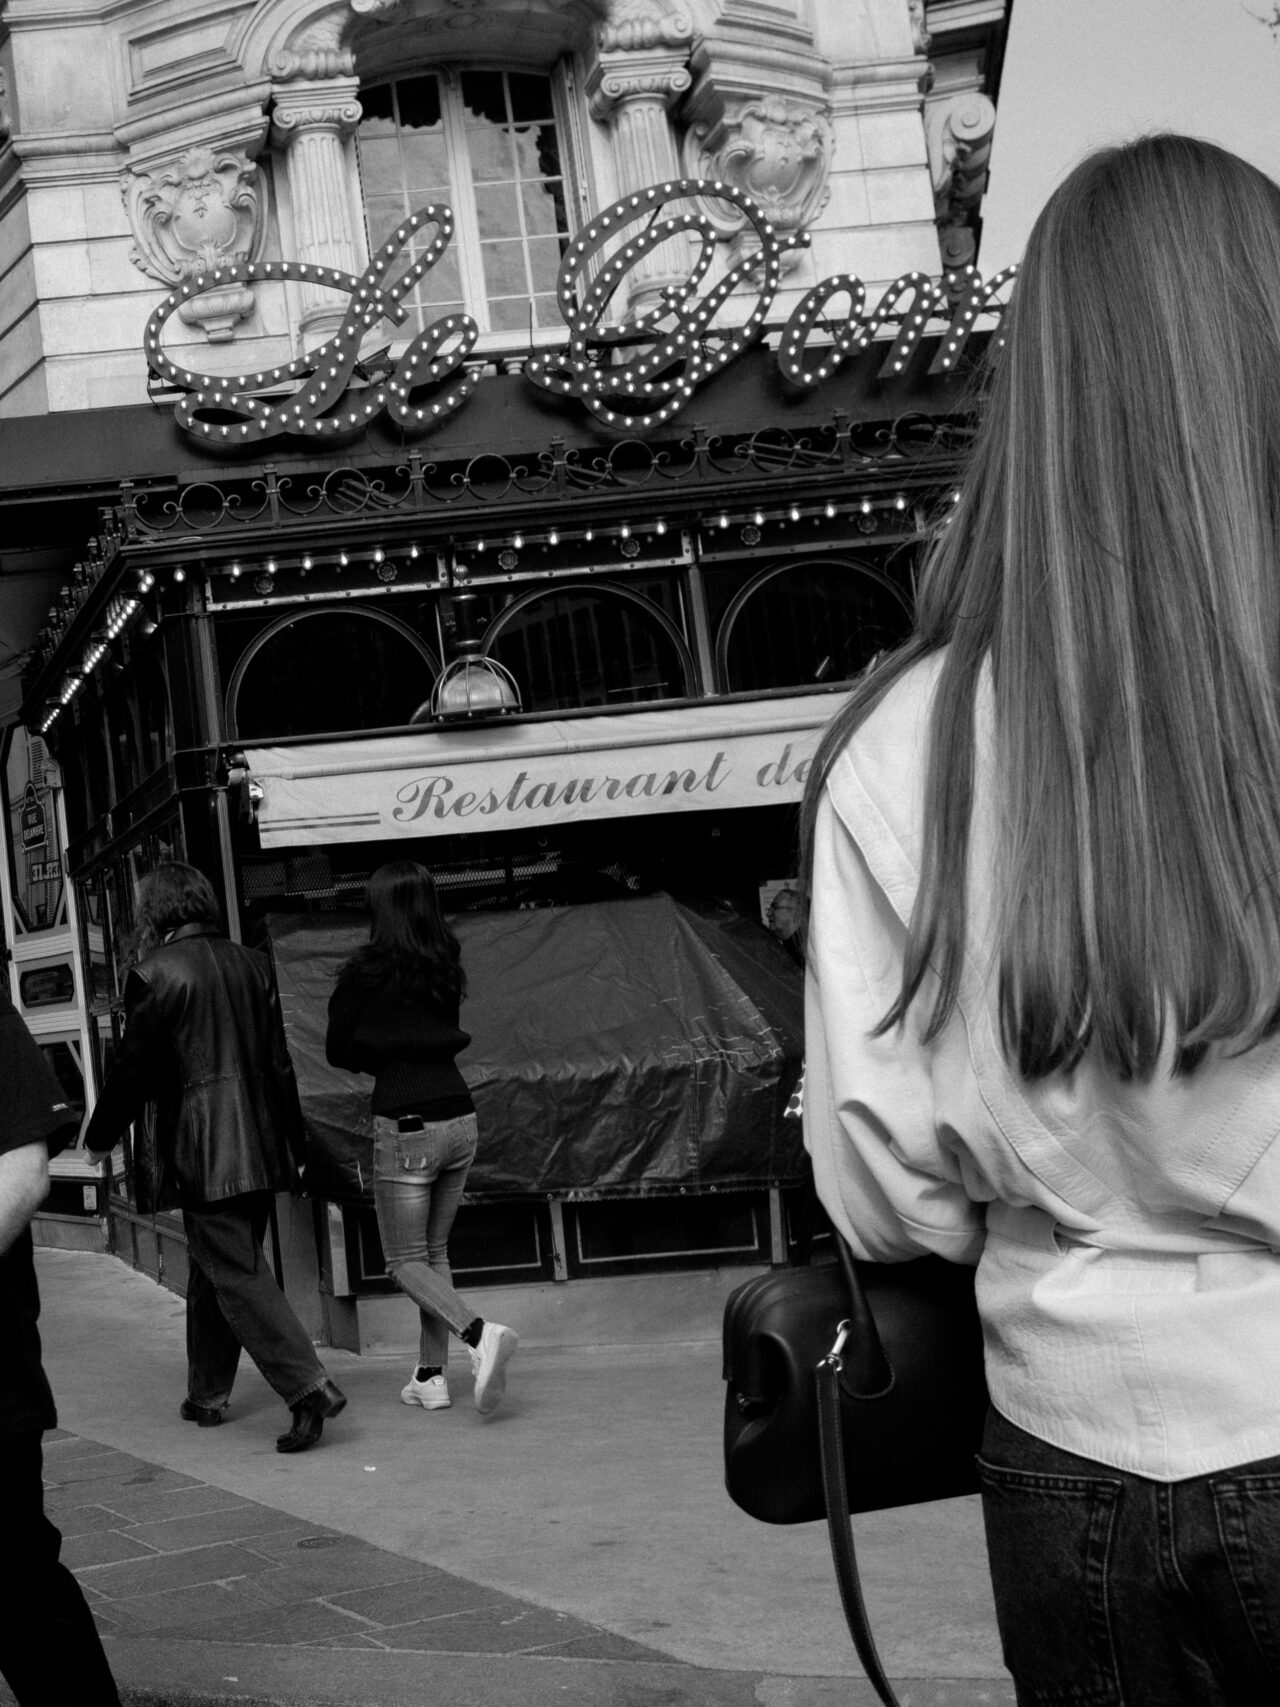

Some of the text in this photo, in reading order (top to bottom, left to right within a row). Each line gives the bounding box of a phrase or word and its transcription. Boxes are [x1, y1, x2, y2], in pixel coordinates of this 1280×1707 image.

[143, 178, 1022, 443] Le Dom
[392, 751, 733, 823] Restaurant
